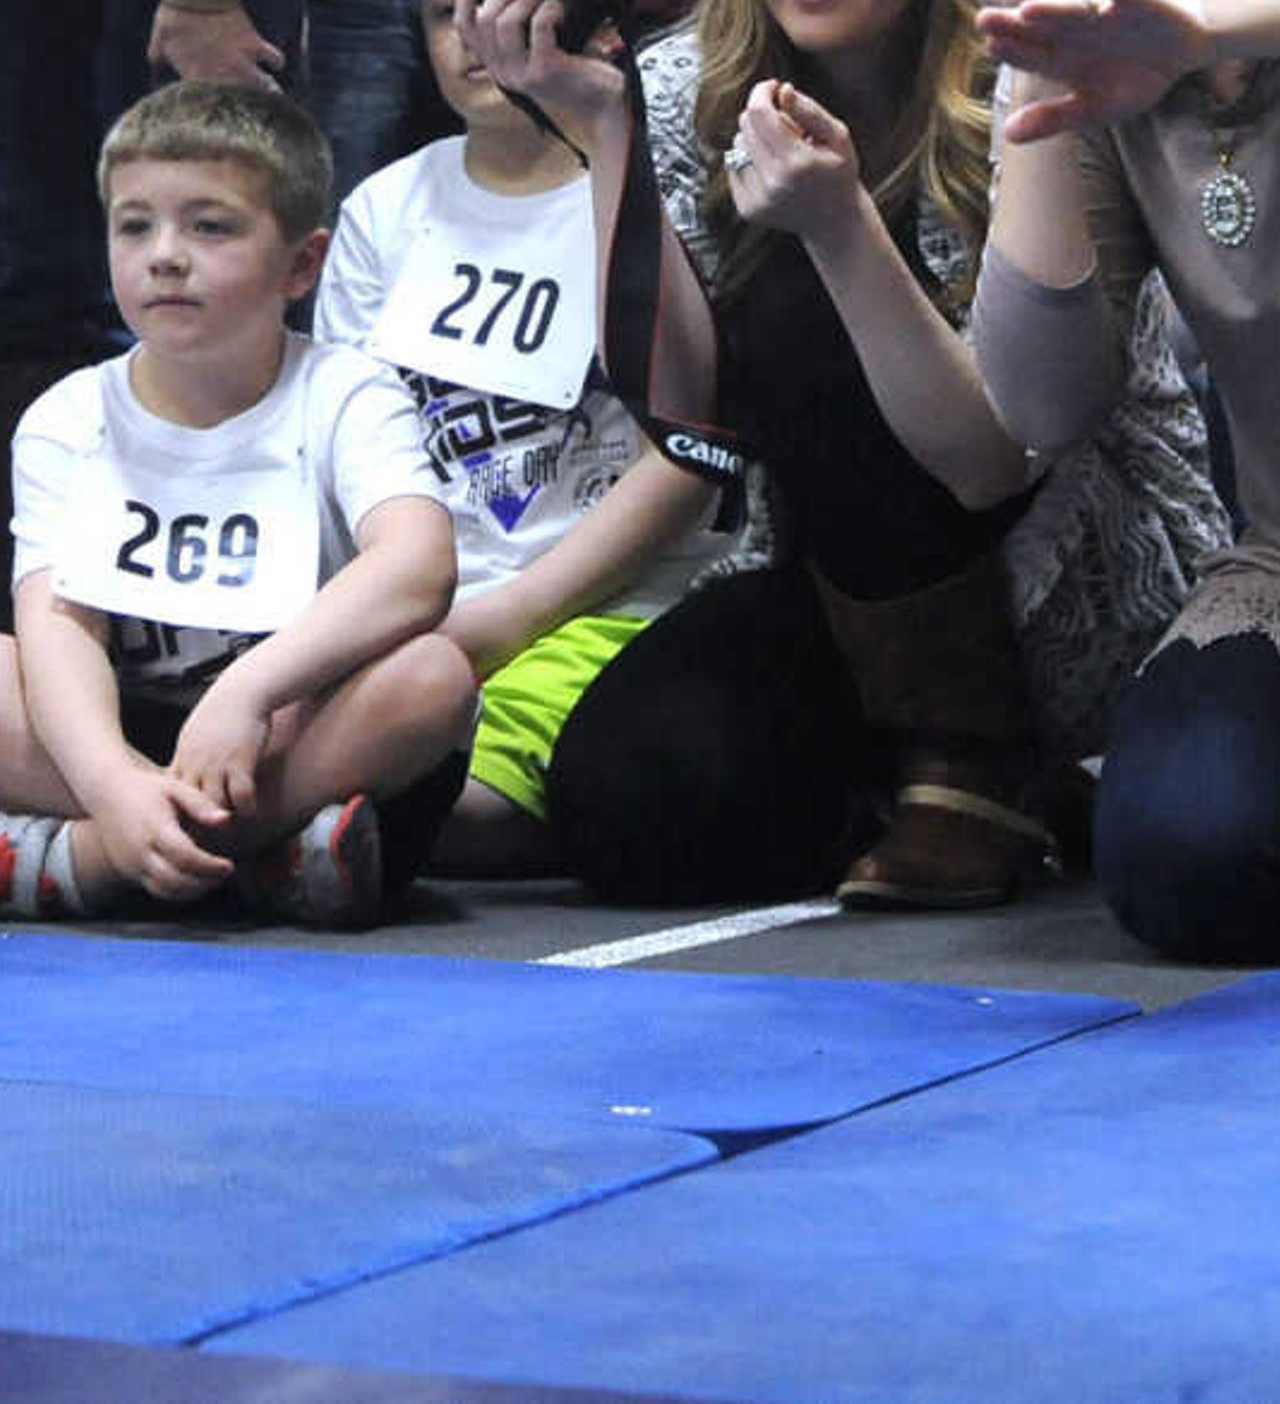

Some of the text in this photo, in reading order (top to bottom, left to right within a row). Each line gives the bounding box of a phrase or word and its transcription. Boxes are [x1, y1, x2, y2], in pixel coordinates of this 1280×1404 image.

[429, 262, 560, 354] 270
[523, 441, 562, 486] DAY
[116, 499, 259, 587] 269
